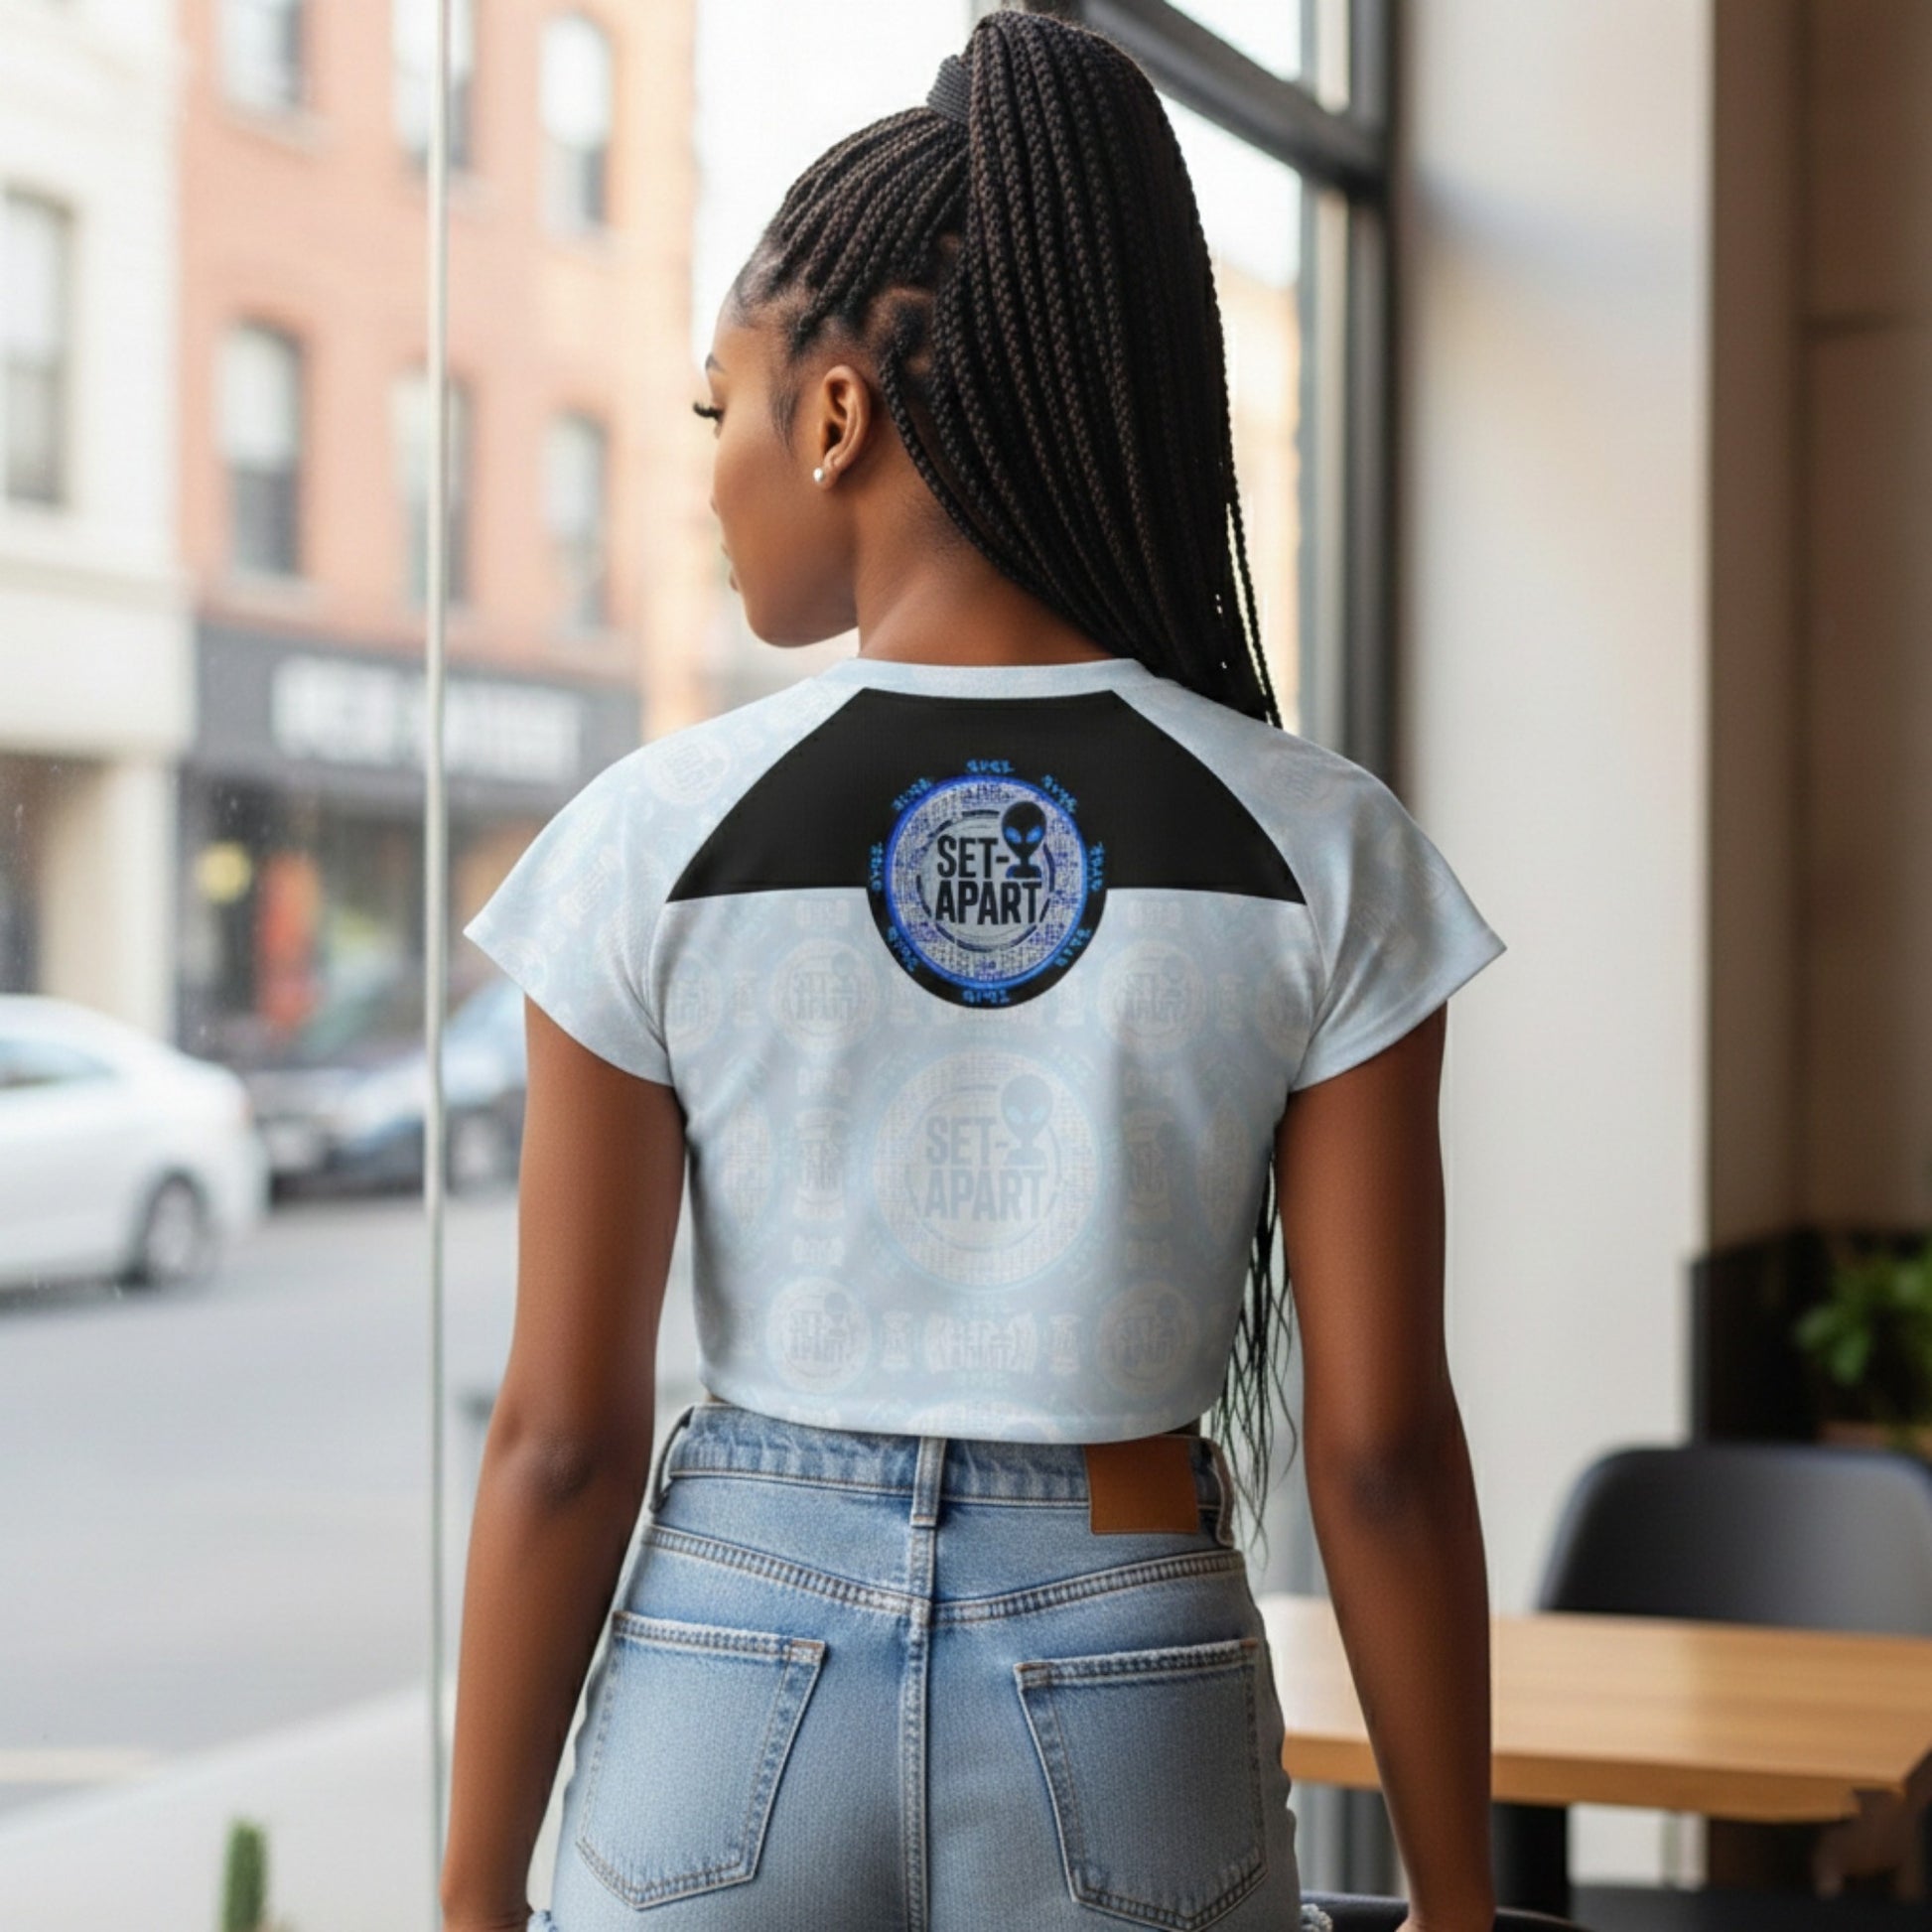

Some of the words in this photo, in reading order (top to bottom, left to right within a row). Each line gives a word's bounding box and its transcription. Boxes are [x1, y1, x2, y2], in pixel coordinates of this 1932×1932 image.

[936, 834, 1010, 880] SET-
[934, 880, 1042, 925] APART
[925, 1115, 1010, 1168] SET-
[923, 1168, 1048, 1222] APART
